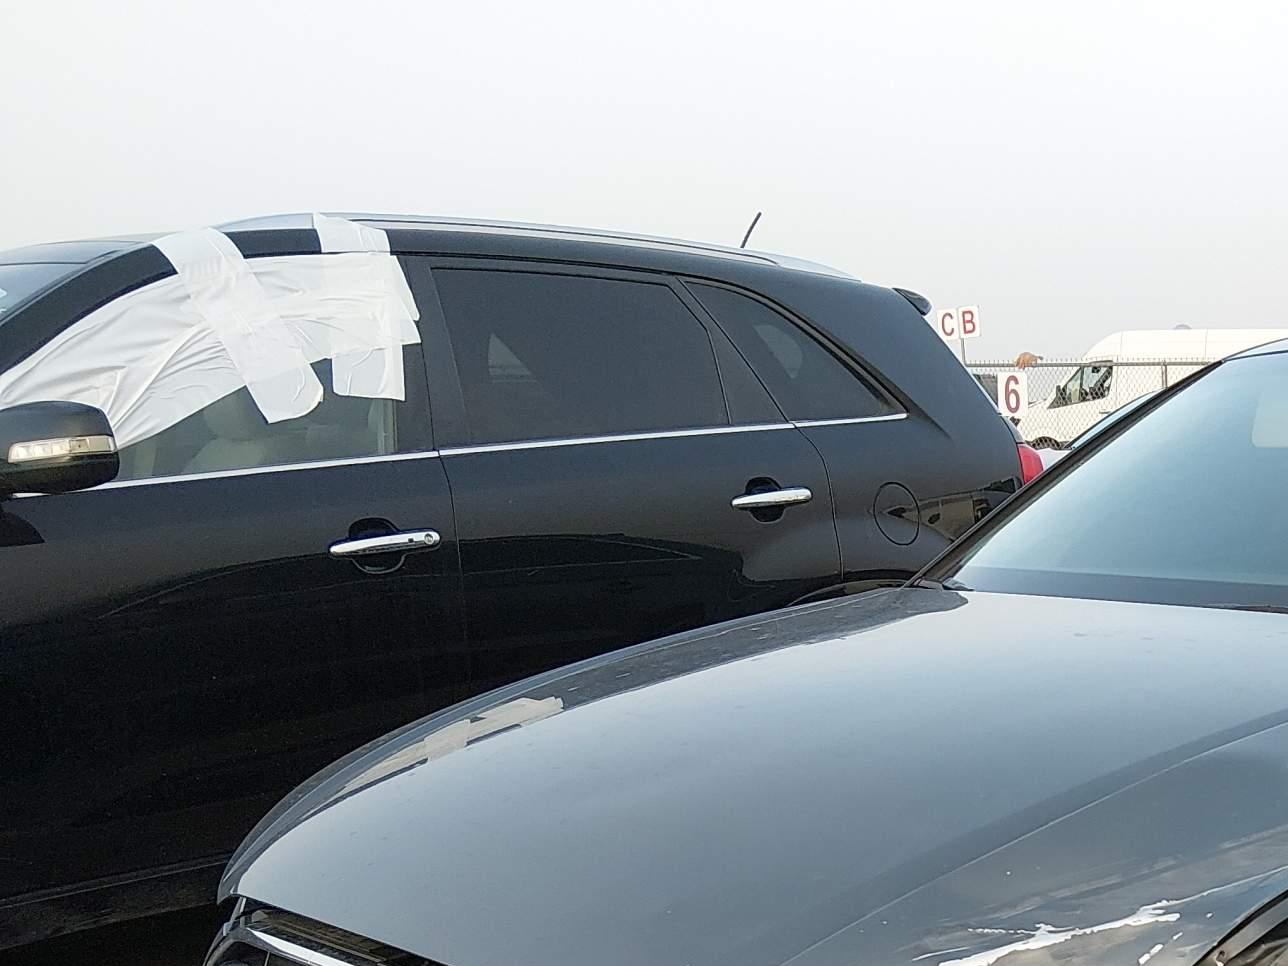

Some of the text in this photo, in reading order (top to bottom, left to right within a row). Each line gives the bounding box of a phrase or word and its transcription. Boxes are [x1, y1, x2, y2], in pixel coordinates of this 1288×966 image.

[941, 310, 977, 336] C B
[1004, 375, 1020, 413] 6
